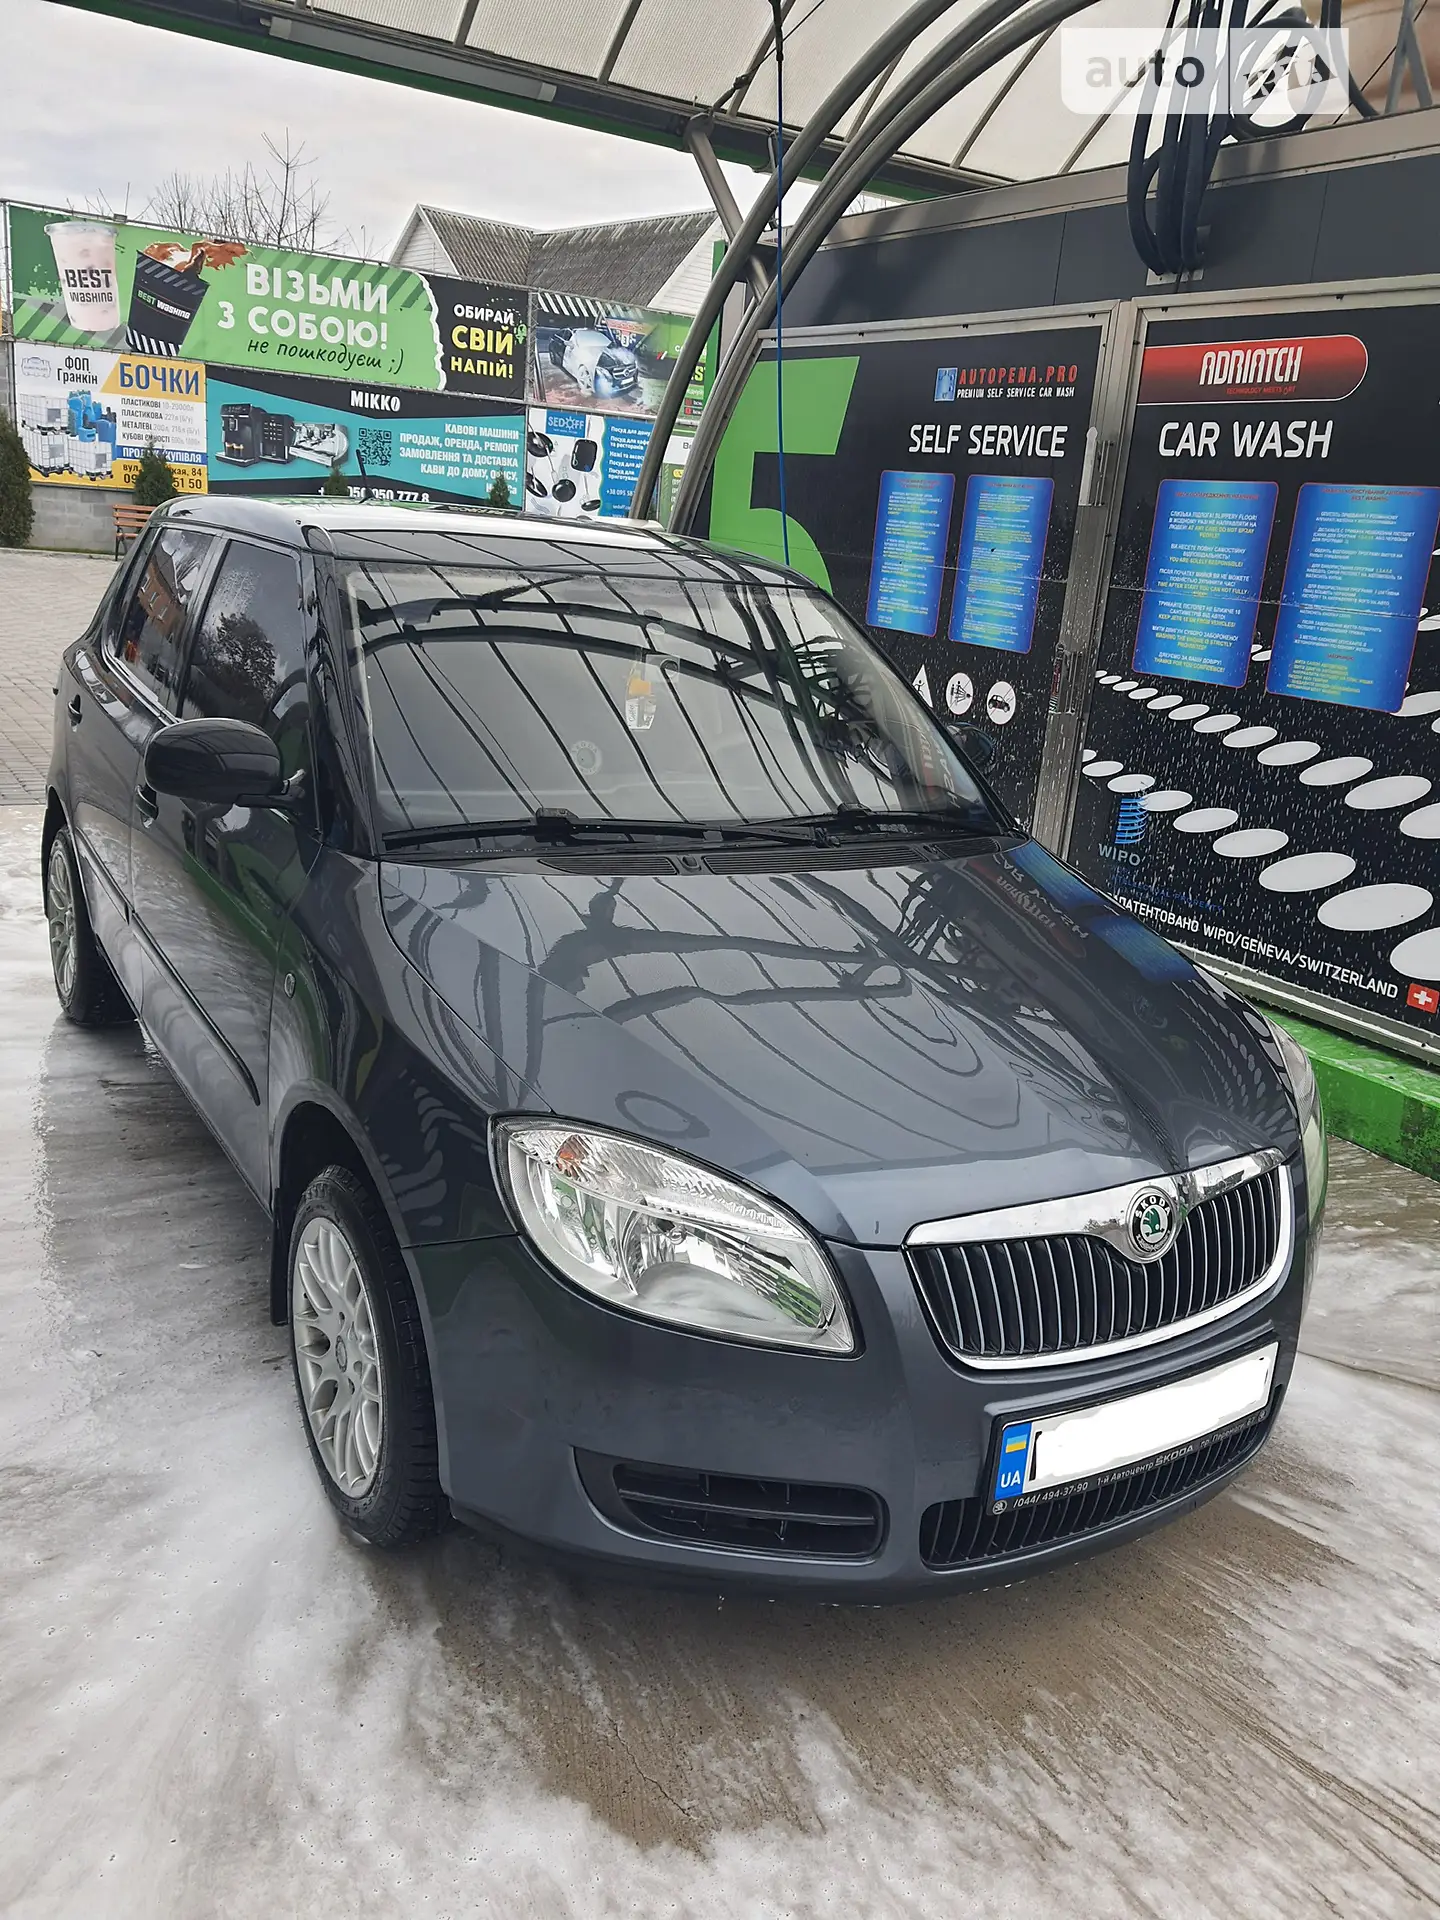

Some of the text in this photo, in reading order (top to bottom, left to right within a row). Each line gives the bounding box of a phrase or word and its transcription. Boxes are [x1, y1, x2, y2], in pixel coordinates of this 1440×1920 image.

[65, 269, 112, 288] BEST
[246, 263, 387, 314] ВІЗЬМИ
[137, 290, 156, 305] BEST
[454, 304, 514, 326] ОБИРАЙ
[248, 306, 387, 350] СОБОЮ!
[452, 325, 513, 356] СВІЙ
[65, 355, 89, 372] ФОП
[248, 340, 269, 353] не
[277, 342, 382, 369] пошкодуєш
[451, 356, 513, 379] НАПІЙ!
[959, 365, 1078, 385] AUTOPENA.PRO
[1199, 346, 1303, 385] ADRIATCH
[57, 368, 98, 385] Гранкін
[120, 362, 199, 396] БОЧКИ
[957, 387, 1075, 398] PREMIUM SELF SERVICE CAR WASH
[121, 398, 161, 408] ПЛАСТИКОВІ
[121, 410, 163, 419] ПЛАСТИКОВА
[548, 416, 584, 430] SEDOFF
[122, 421, 152, 430] МЕТАЛЕВІ
[445, 423, 519, 440] КАВОВІ МАШИНИ
[122, 433, 143, 441] КУБОВІ
[400, 433, 519, 453] ПРОДАЖ, ОРЕНДА, РЕМОНТ
[908, 424, 1068, 457] SELF SERVICE
[1158, 420, 1334, 459] CAR WASH
[400, 447, 518, 467] ЗАМОВЛЕННЯ ТА ДОСТАВКА
[191, 468, 202, 476] 84
[421, 464, 445, 475] КАВИ
[447, 466, 460, 477] ДО
[462, 468, 488, 480] ДОМУ,
[189, 479, 202, 489] 50
[1099, 843, 1140, 866] WIPO
[1203, 923, 1399, 999] WIPO/GENEVA/SWITZERLAND
[1000, 1471, 1021, 1488] UA
[1042, 1482, 1088, 1501] 494-37-90
[1111, 1462, 1153, 1482] Автоцентр
